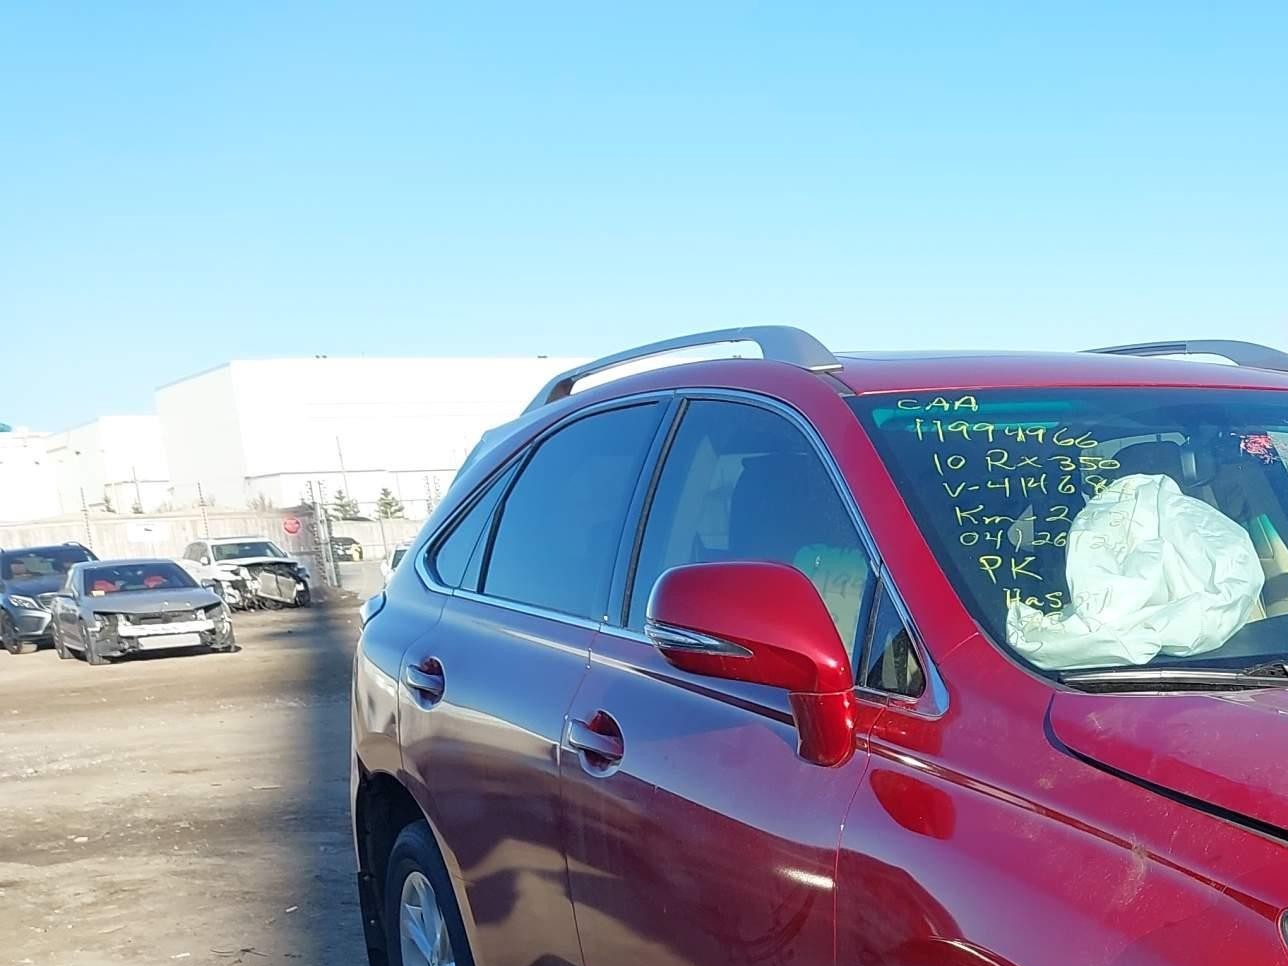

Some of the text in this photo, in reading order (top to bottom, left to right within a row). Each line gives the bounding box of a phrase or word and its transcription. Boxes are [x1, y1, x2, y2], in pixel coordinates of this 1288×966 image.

[897, 395, 979, 412] CAA
[915, 417, 1099, 449] 11994966
[933, 452, 967, 477] 10
[1047, 455, 1121, 472] 350
